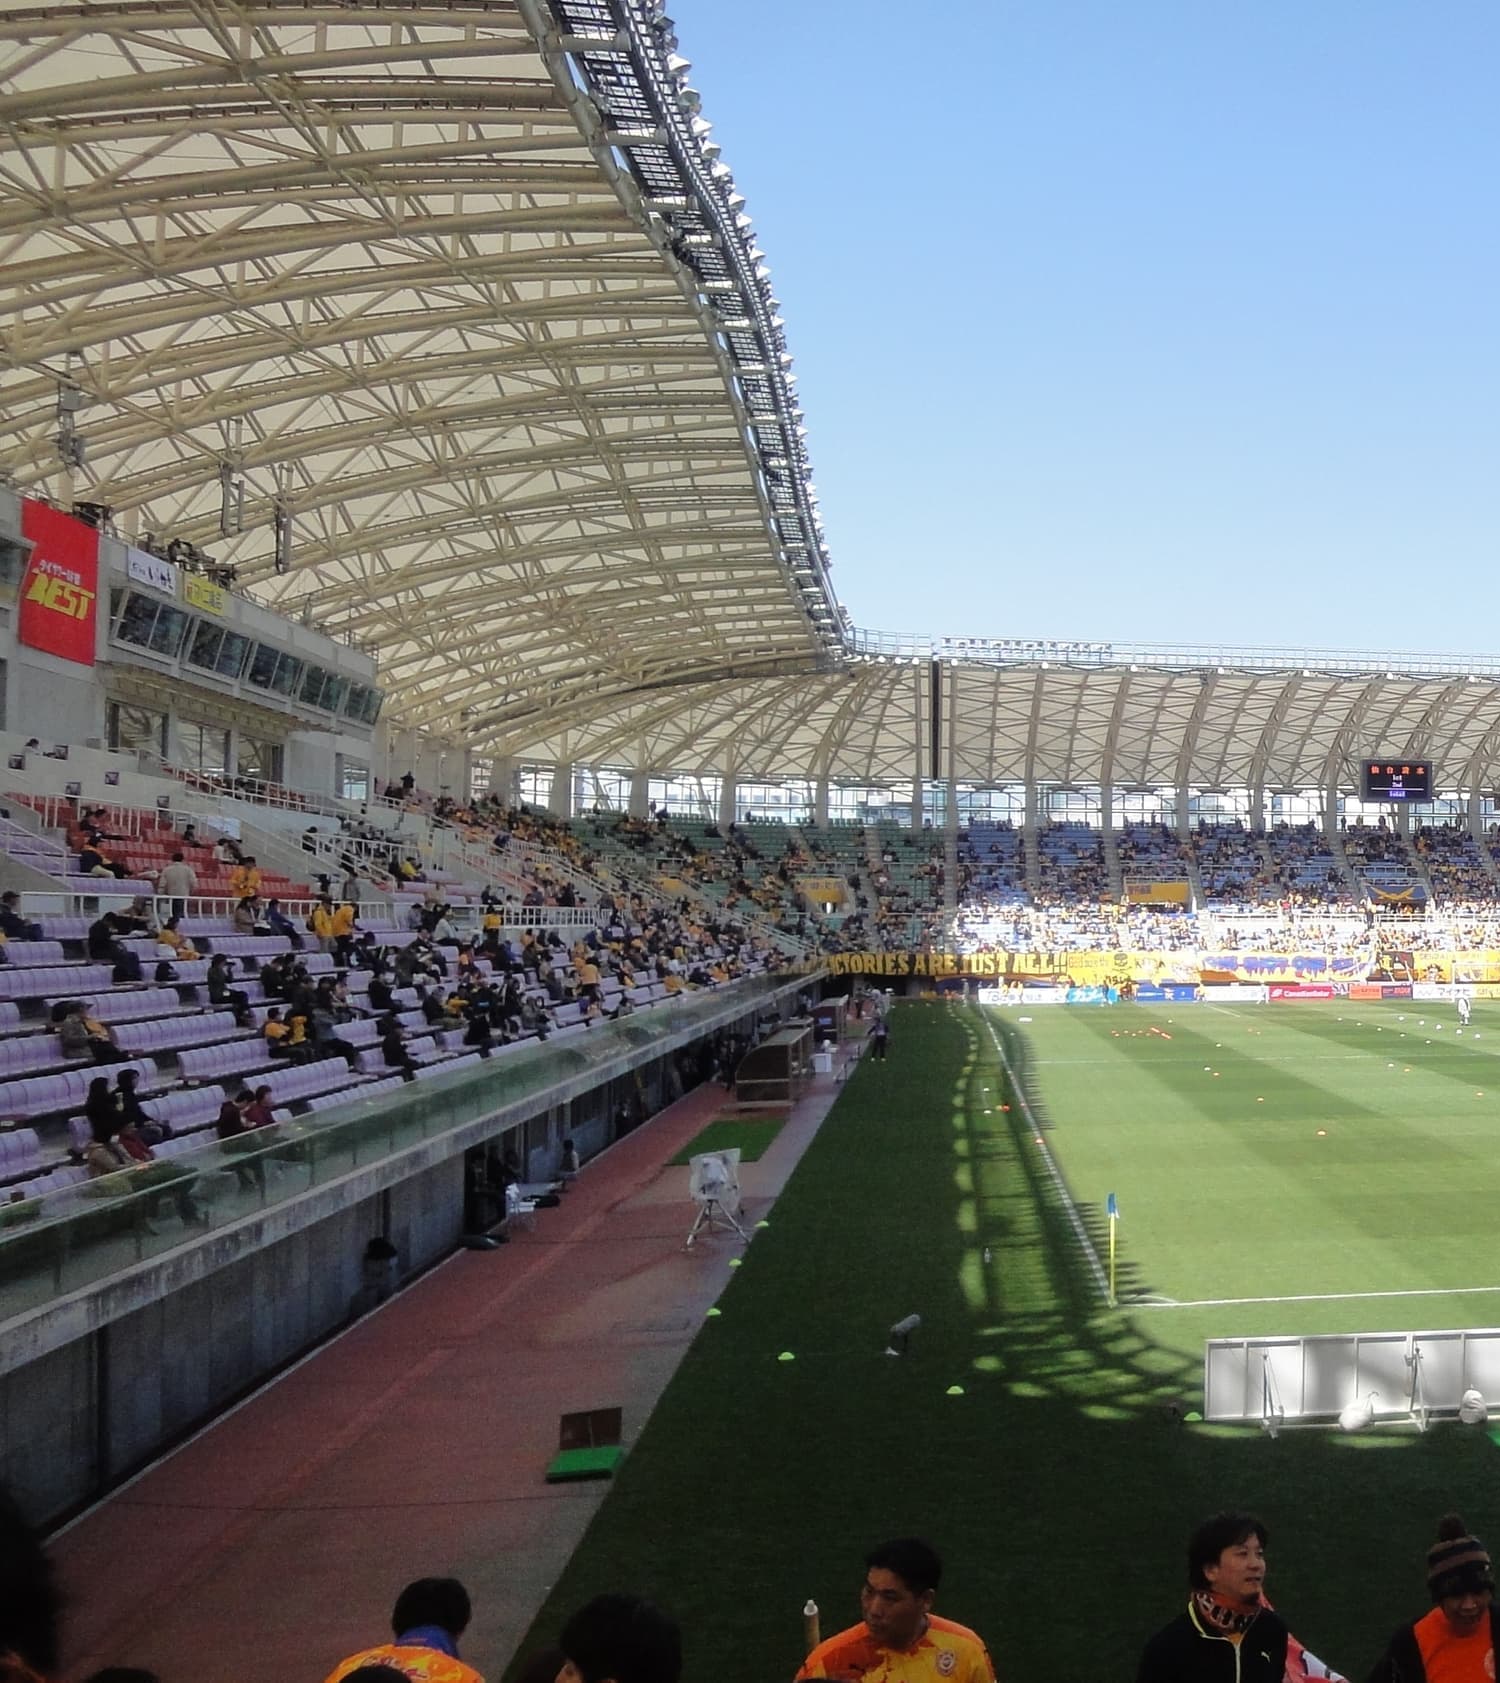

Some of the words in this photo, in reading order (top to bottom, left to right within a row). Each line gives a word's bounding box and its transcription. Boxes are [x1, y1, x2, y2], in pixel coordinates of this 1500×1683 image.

[26, 568, 96, 620] BEST
[913, 952, 957, 975] ARE
[962, 952, 1010, 975] JUST
